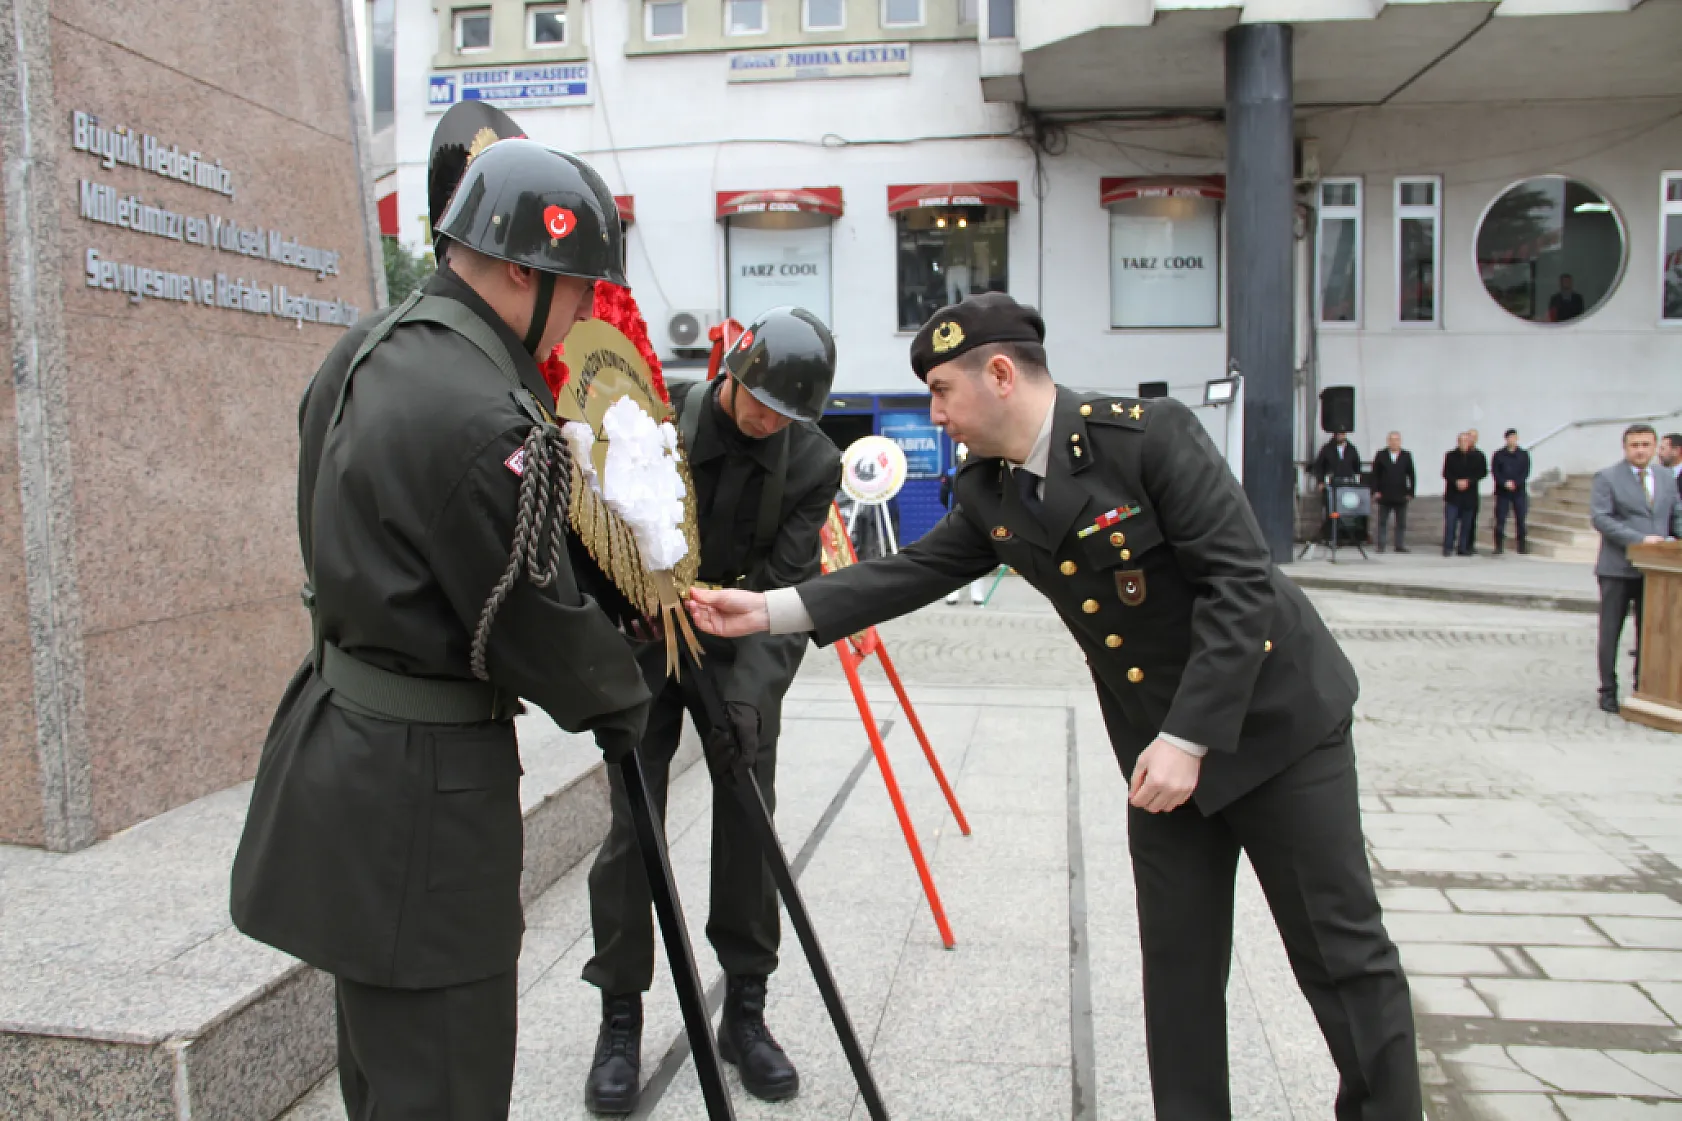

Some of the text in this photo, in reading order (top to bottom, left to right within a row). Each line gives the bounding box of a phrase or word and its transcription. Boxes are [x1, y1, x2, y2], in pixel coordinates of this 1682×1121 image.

[786, 51, 842, 67] MODA
[463, 70, 509, 84] SERBEST
[71, 110, 141, 169] Büyük
[1136, 187, 1201, 198] TARZ COOL
[918, 195, 983, 206] TARZ COOL
[738, 203, 801, 213] TARZ COOL
[185, 216, 208, 244] en
[1121, 256, 1204, 269] TARZ COOL
[741, 264, 818, 277] TARZ COOL
[192, 276, 214, 306] ve
